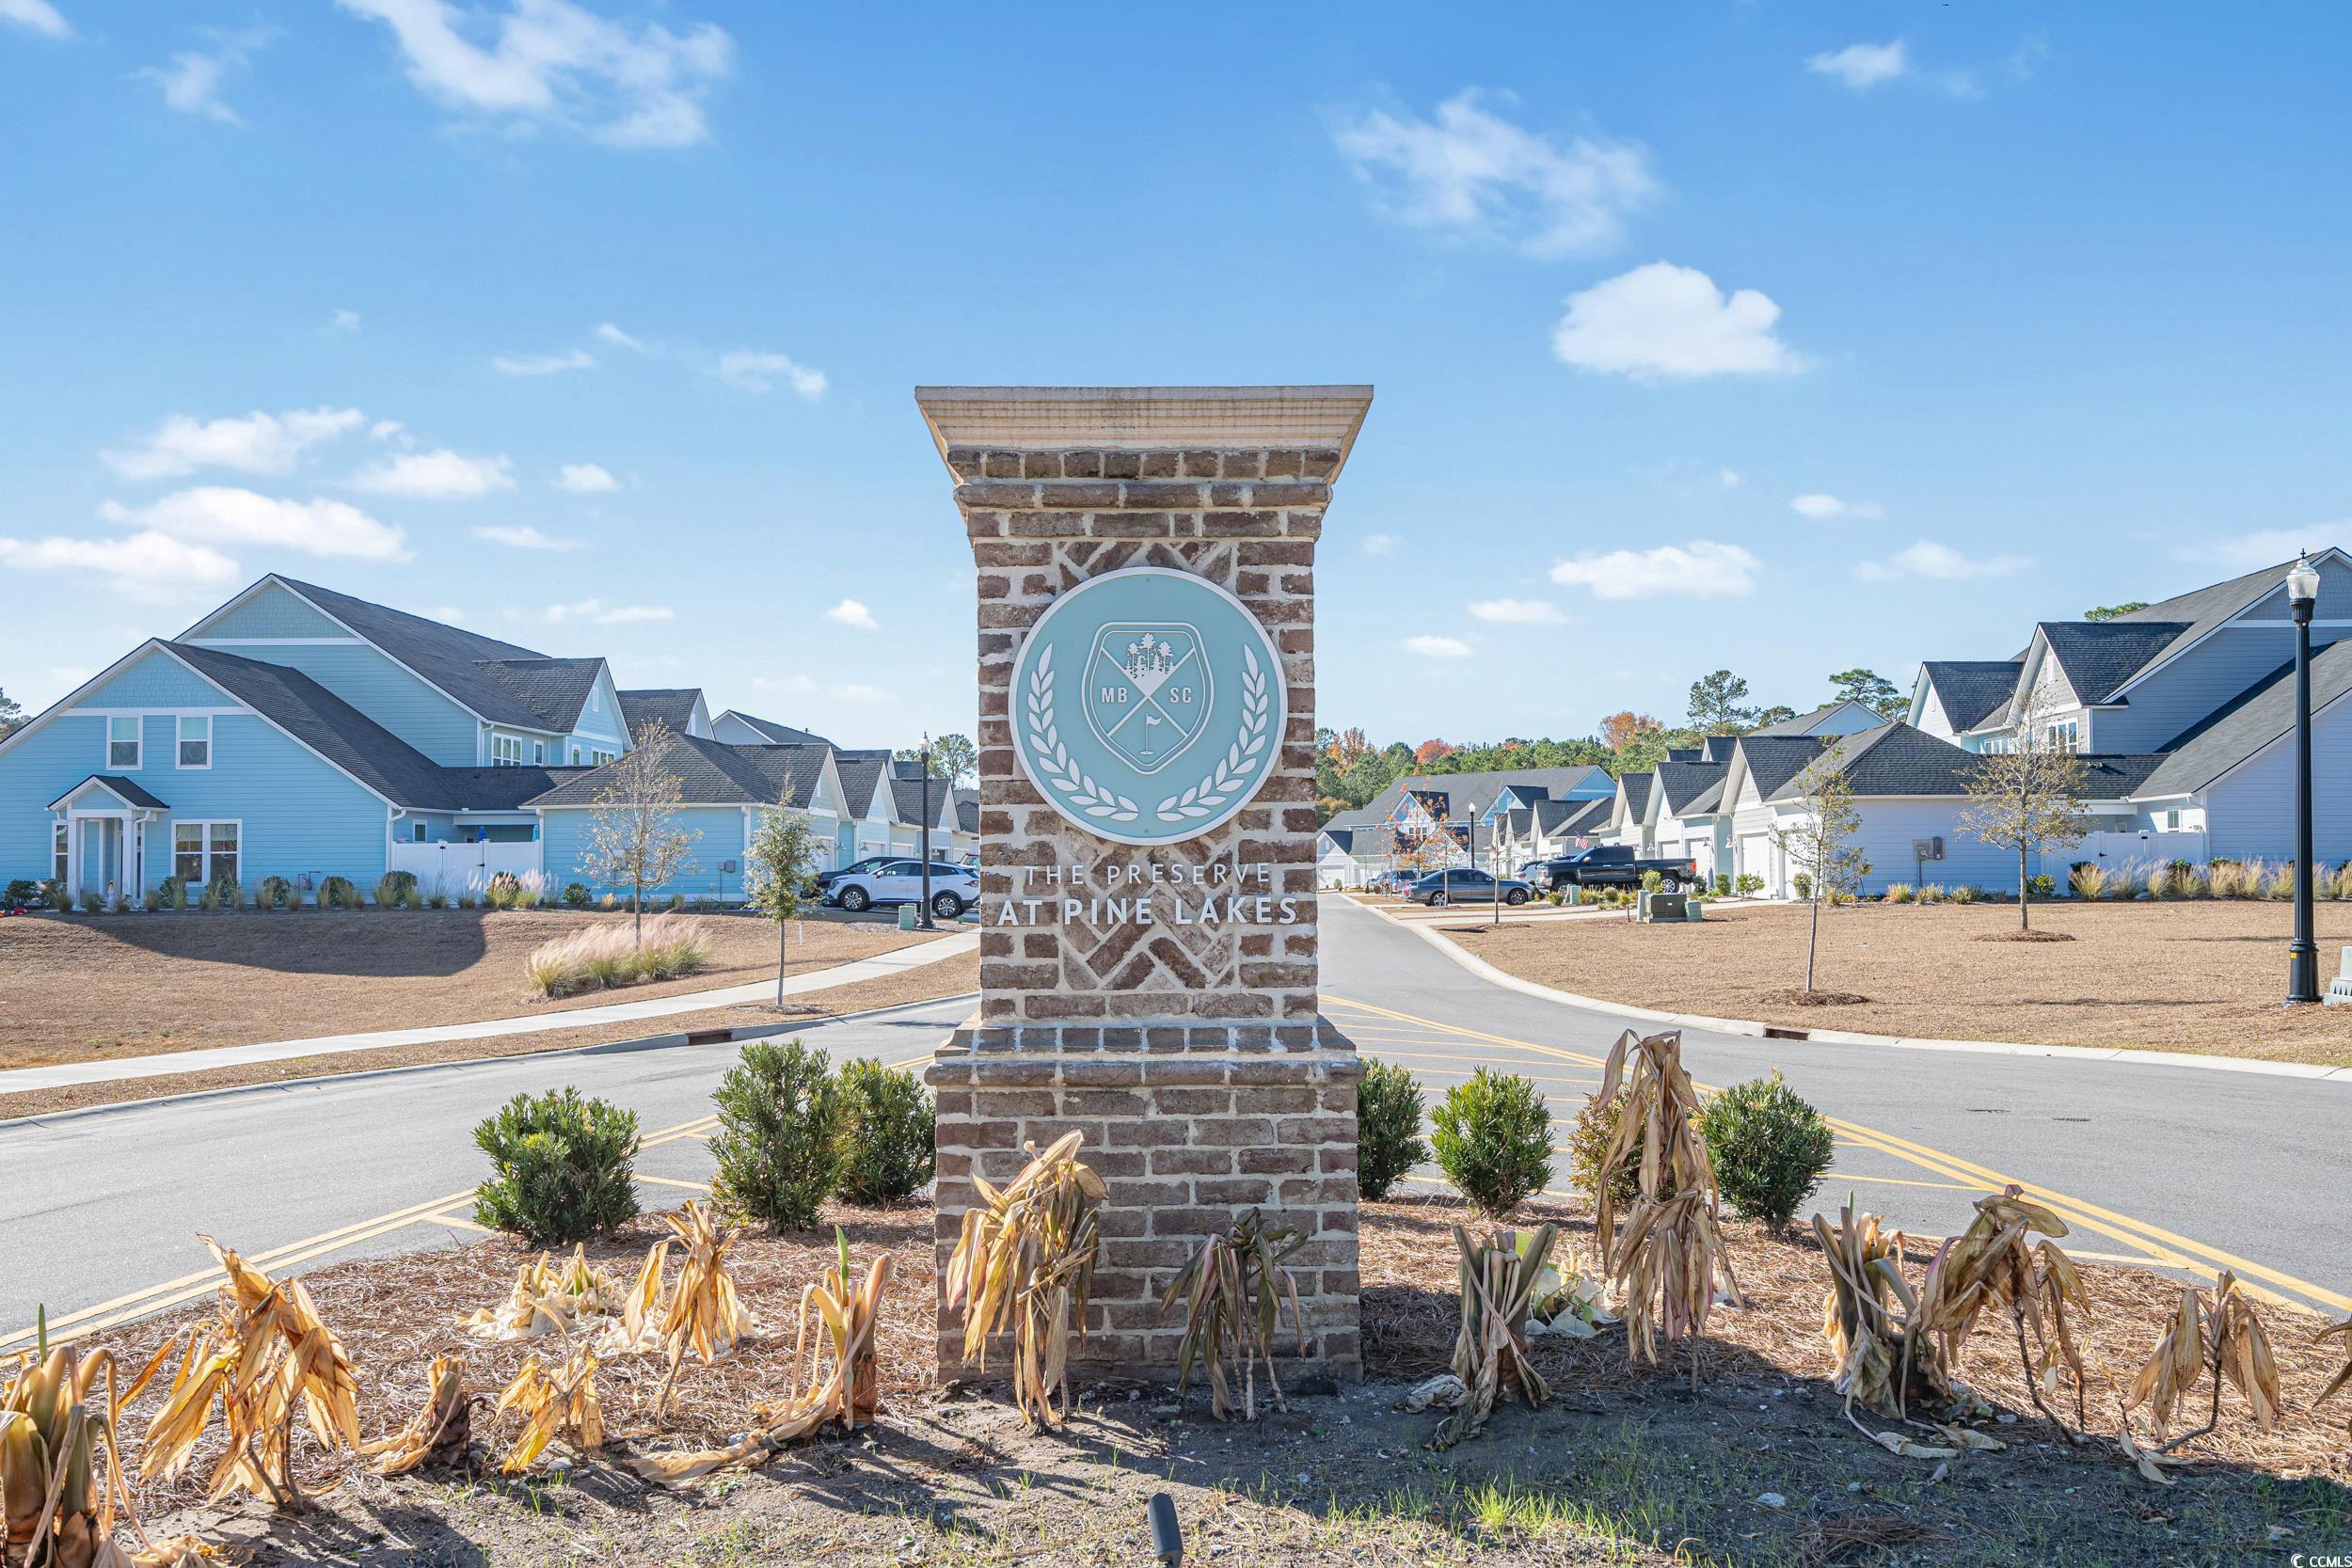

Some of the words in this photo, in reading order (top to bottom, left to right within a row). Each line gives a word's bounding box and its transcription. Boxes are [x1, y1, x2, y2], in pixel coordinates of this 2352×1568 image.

[1102, 687, 1128, 703] MB
[1169, 687, 1192, 704] SC
[1024, 864, 1084, 886] THE
[1107, 863, 1270, 885] PRESERVE
[997, 899, 1043, 927] AT
[1064, 897, 1152, 926] PINE
[1175, 896, 1297, 925] LAKES
